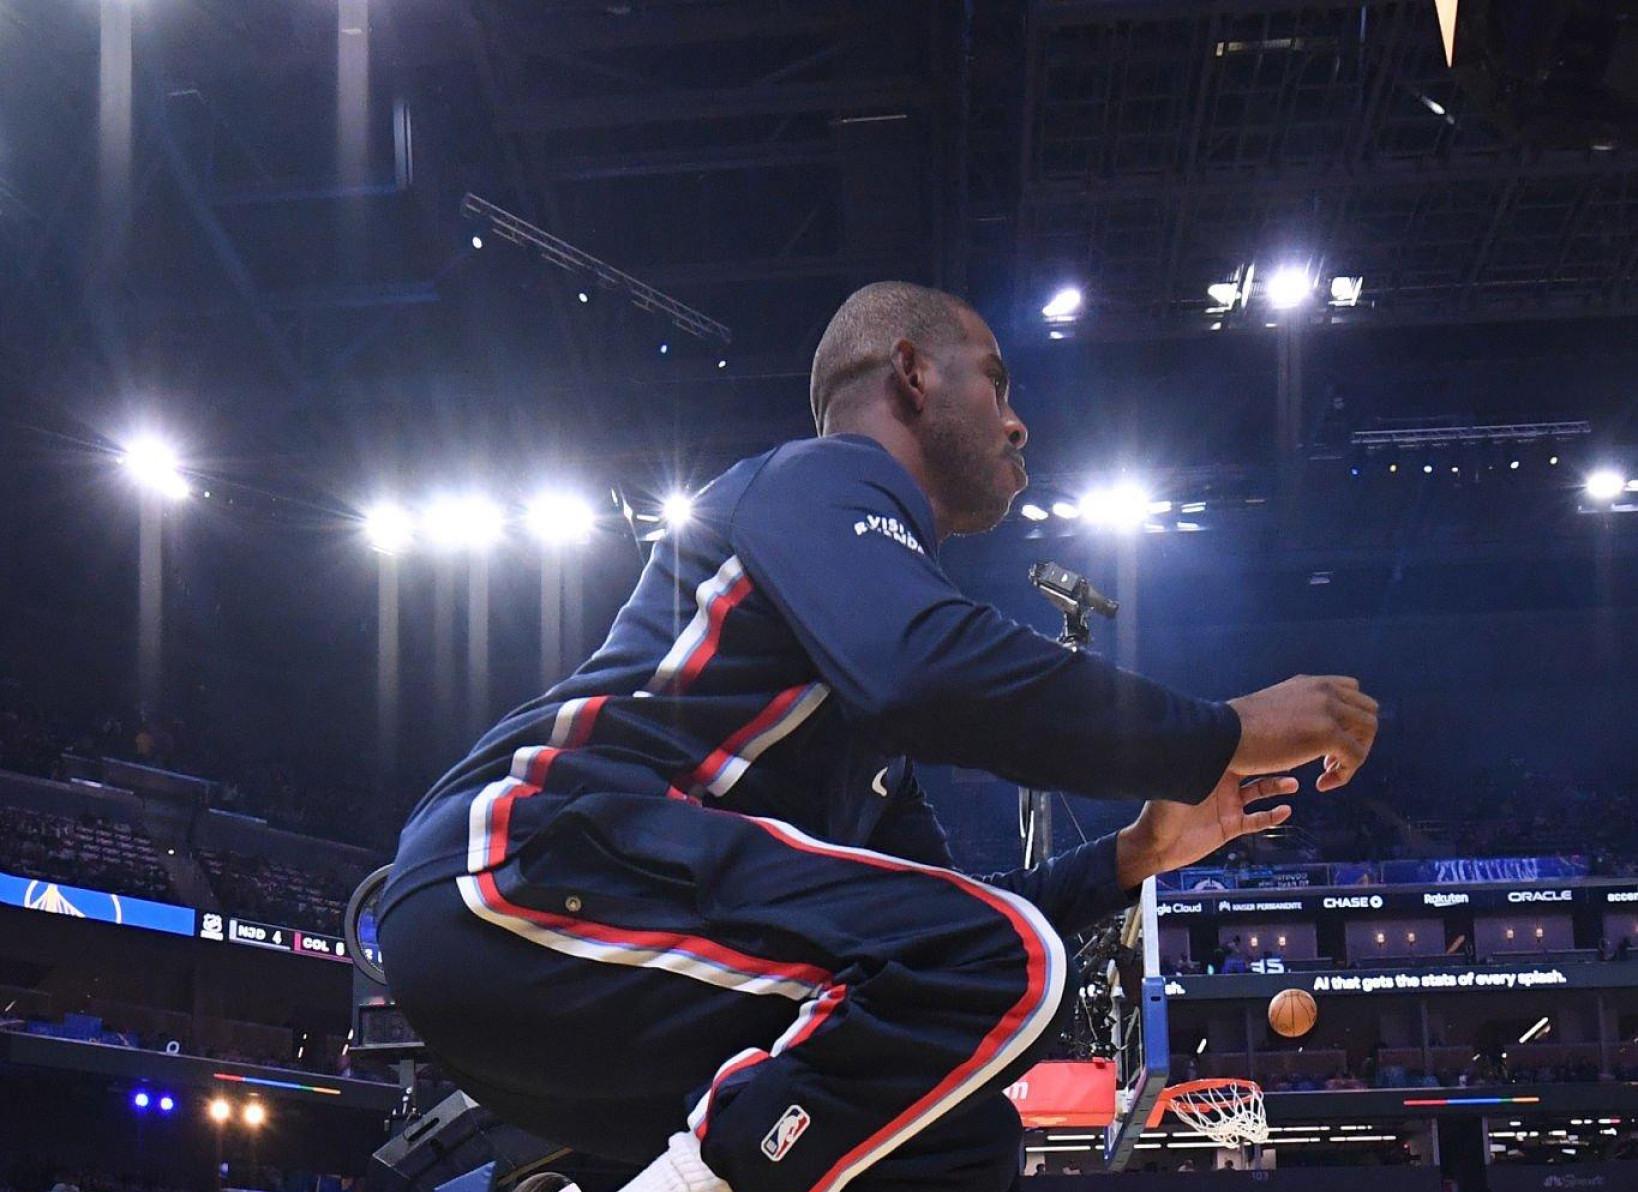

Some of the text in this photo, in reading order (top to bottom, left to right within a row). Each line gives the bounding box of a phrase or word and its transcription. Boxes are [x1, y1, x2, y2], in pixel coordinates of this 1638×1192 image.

[1323, 896, 1368, 908] CHASE
[1424, 893, 1469, 907] Rakuten
[1507, 890, 1573, 902] ORACLE
[1172, 902, 1202, 913] Cloud
[303, 937, 330, 952] COL
[1313, 969, 1567, 993] AI that gets the stats of every splash.
